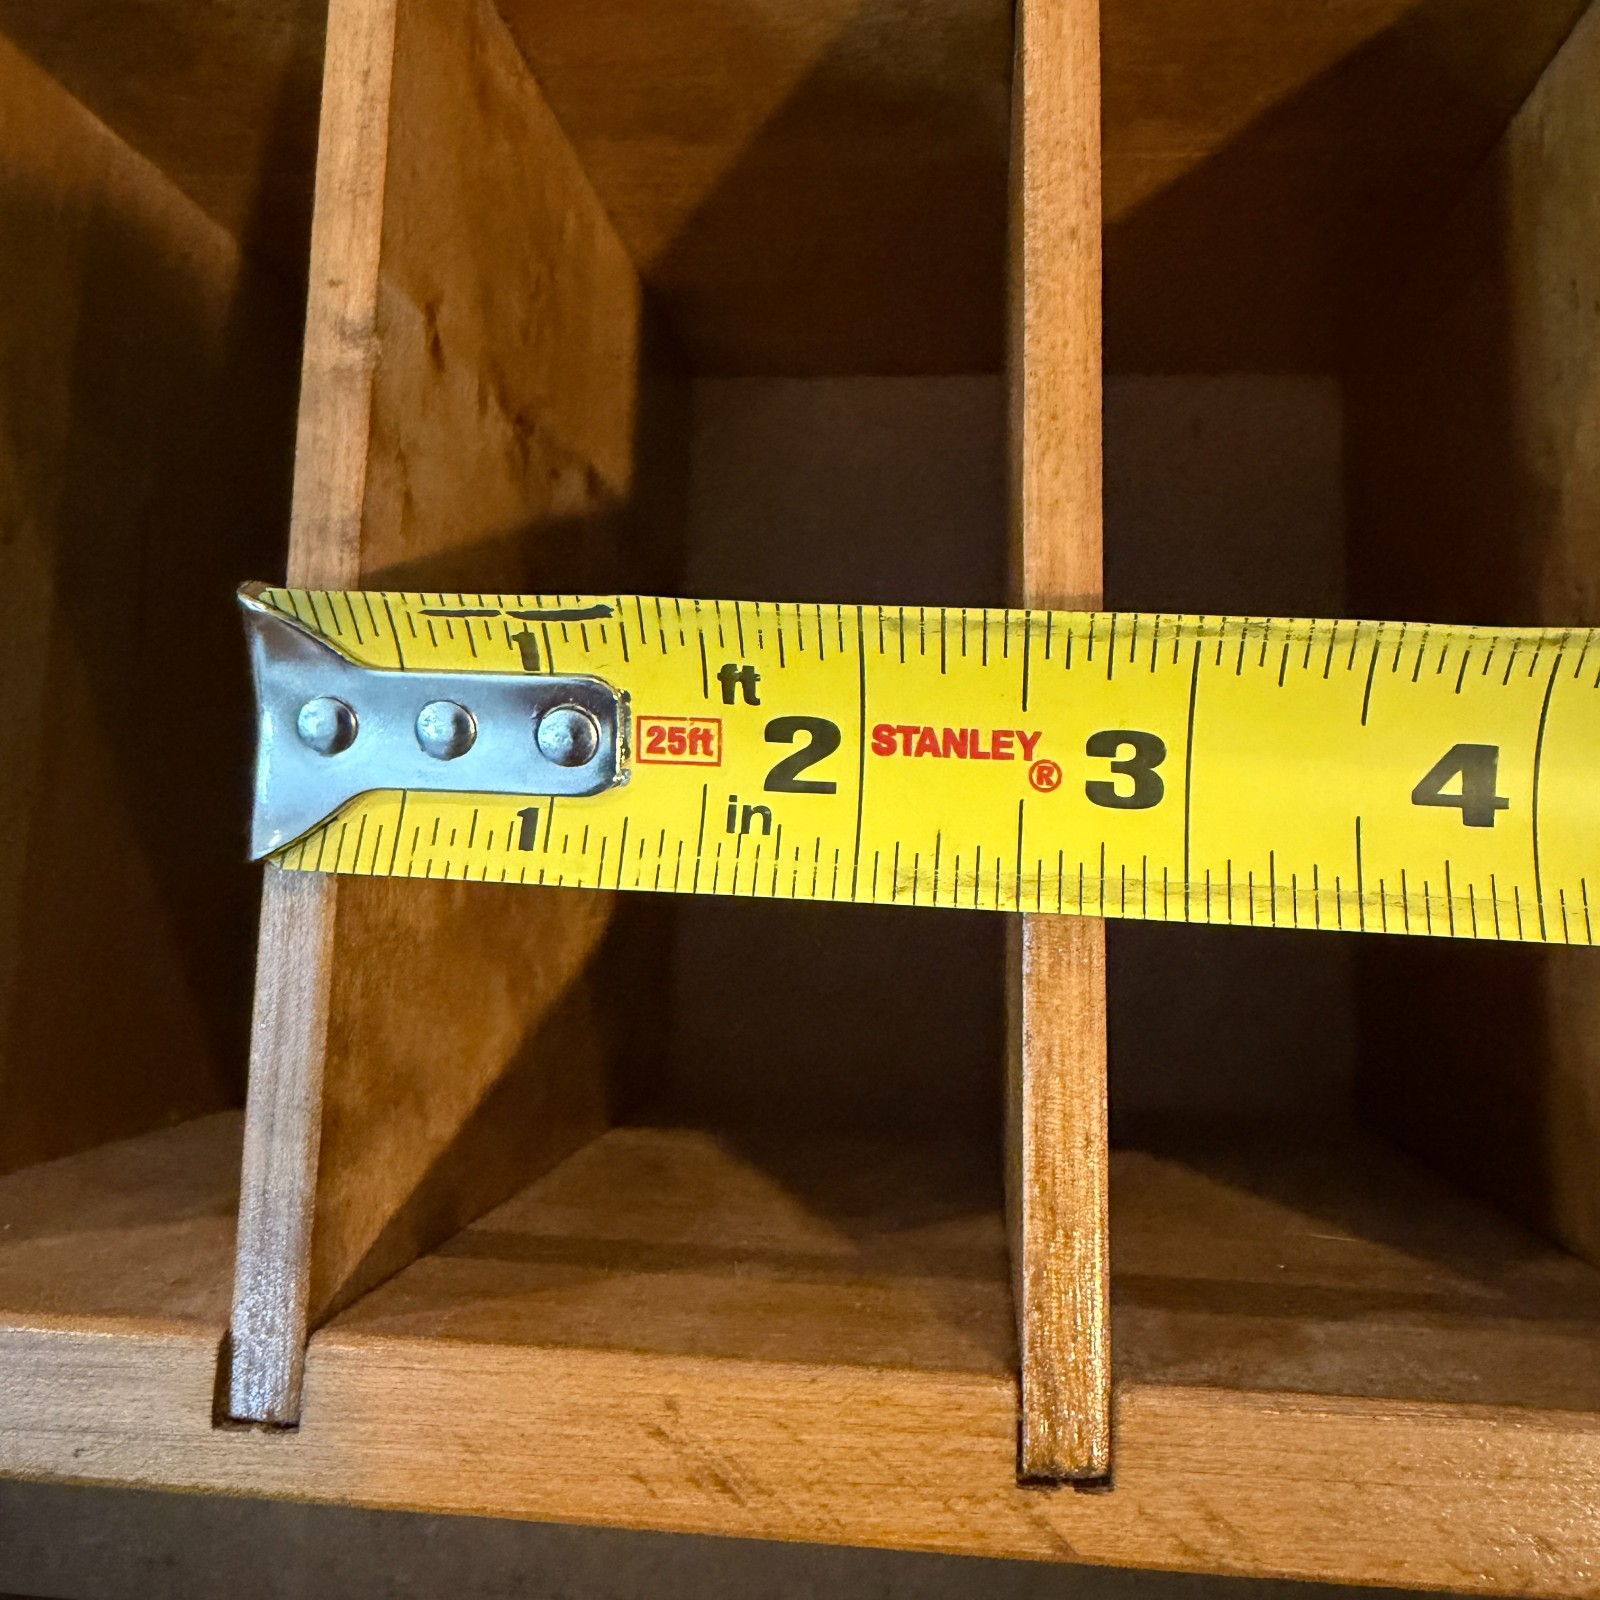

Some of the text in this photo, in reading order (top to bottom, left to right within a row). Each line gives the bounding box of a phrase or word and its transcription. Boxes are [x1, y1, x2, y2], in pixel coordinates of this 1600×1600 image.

[512, 631, 540, 671] 1
[717, 663, 761, 706] ft
[646, 720, 715, 758] 25ft
[764, 716, 841, 795] 2
[871, 723, 1043, 761] STANLEY
[1085, 730, 1167, 810] 3
[1411, 743, 1510, 828] 4
[517, 807, 539, 852] 1
[726, 795, 772, 836] in
